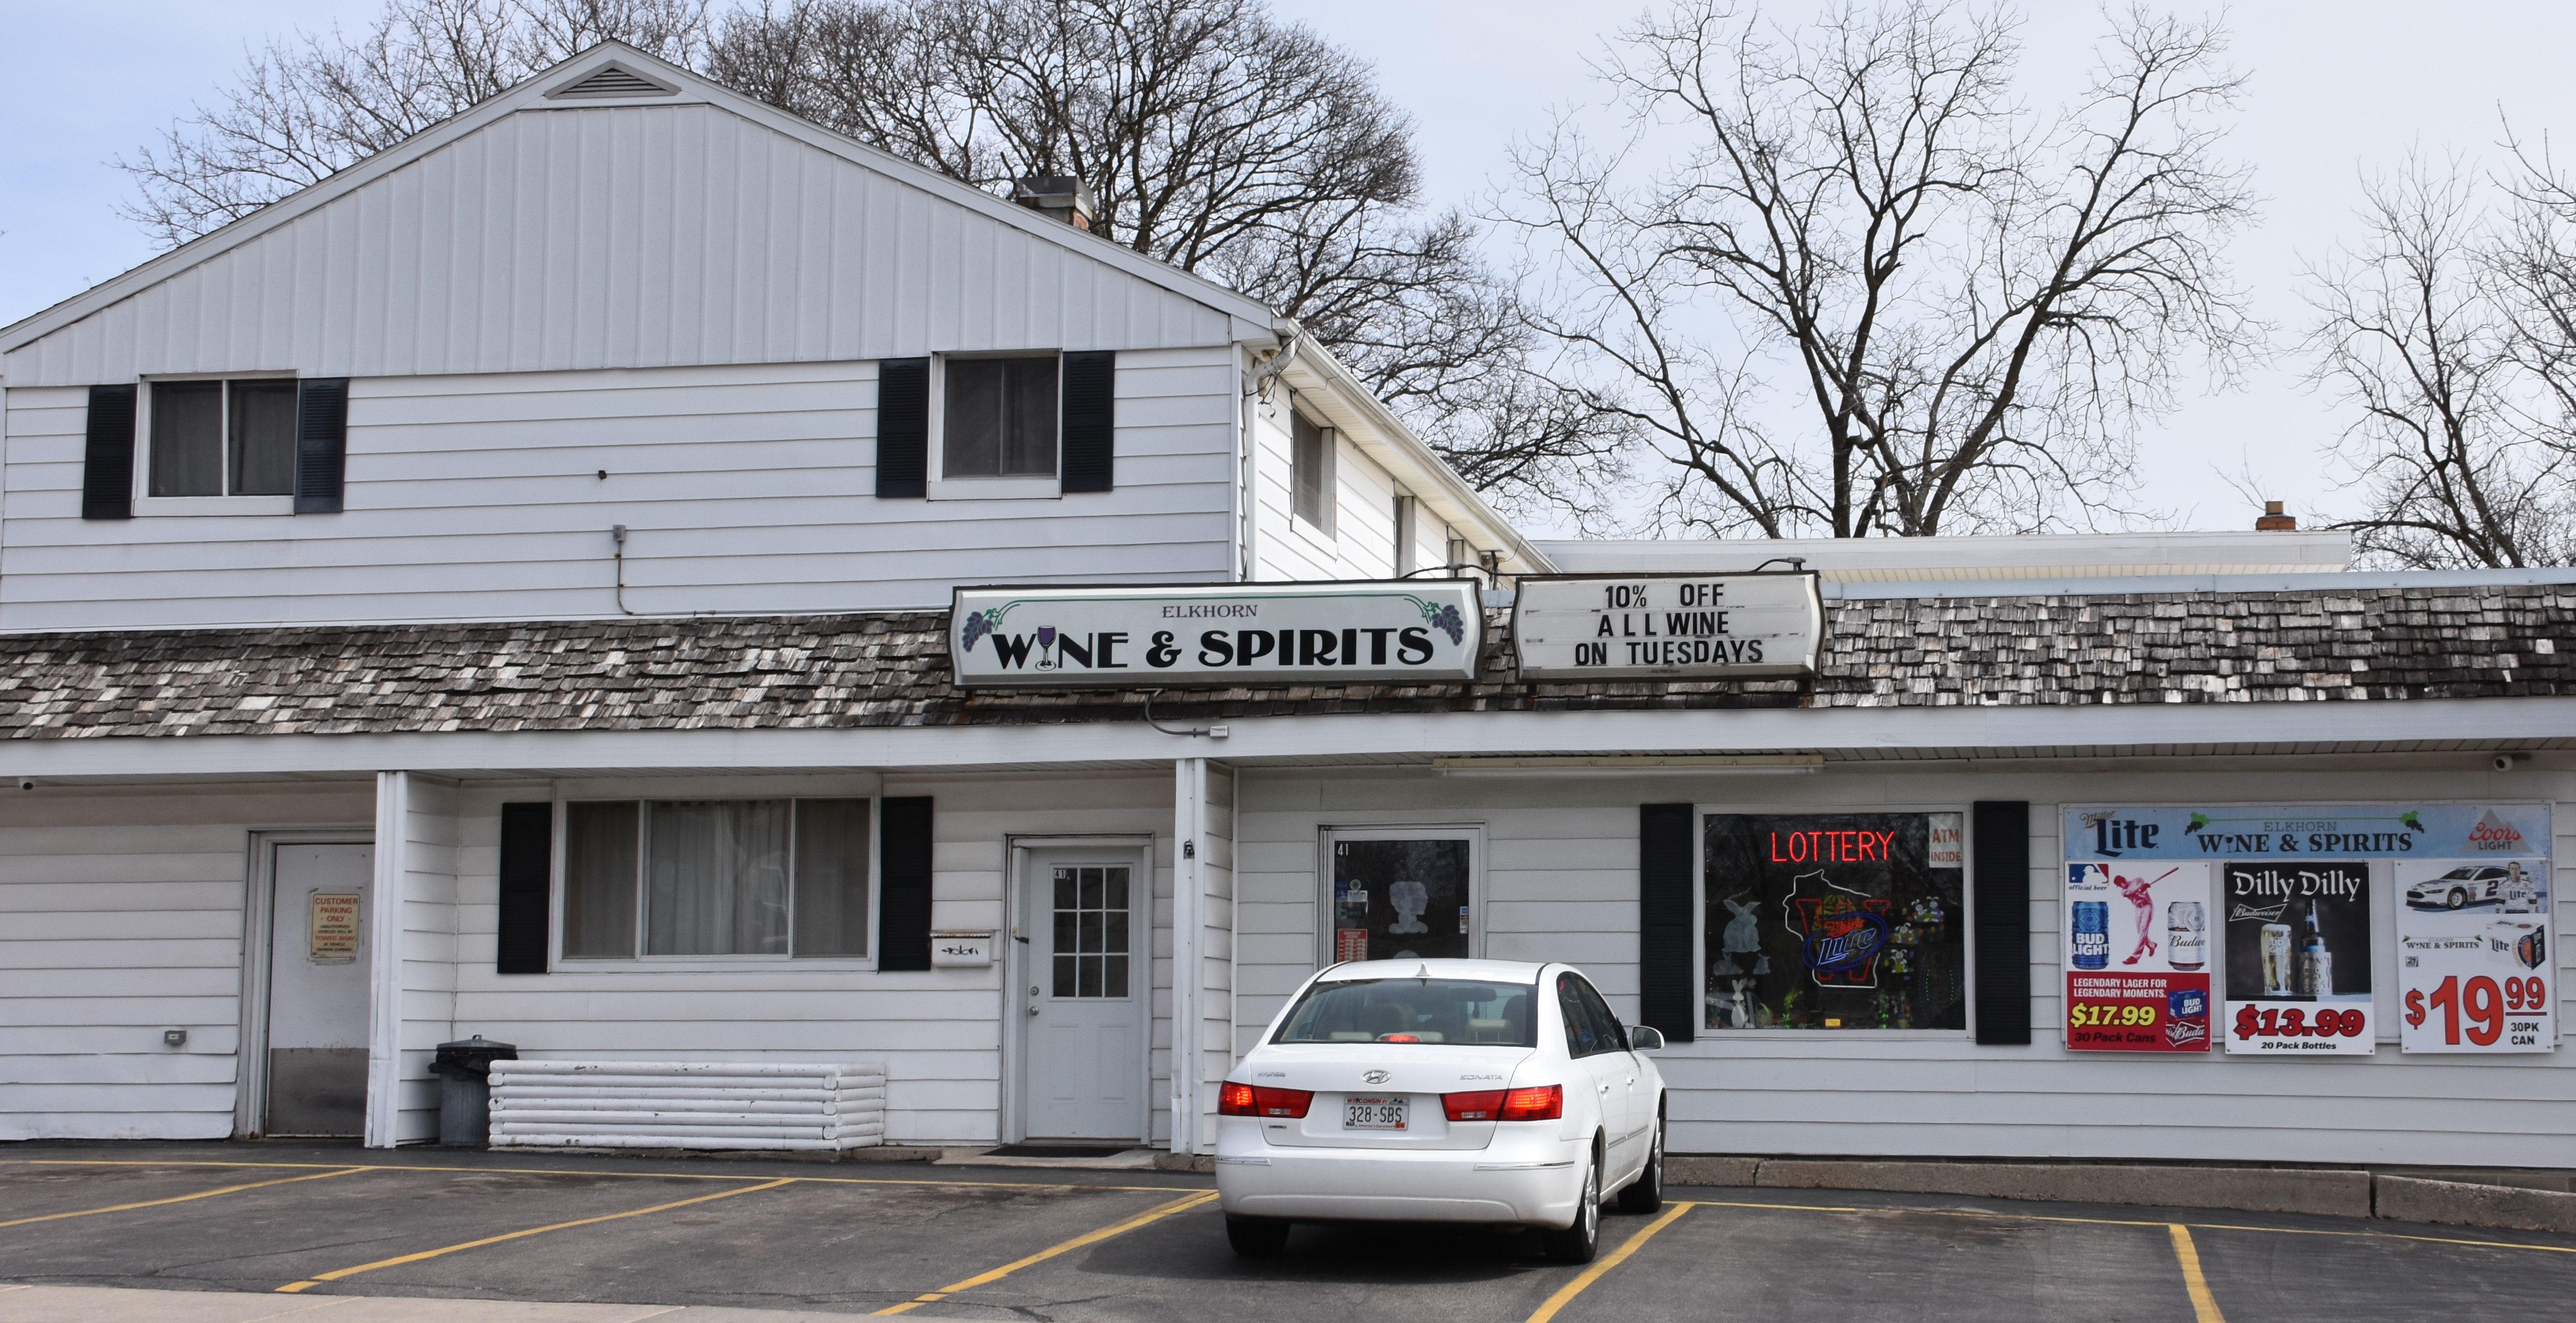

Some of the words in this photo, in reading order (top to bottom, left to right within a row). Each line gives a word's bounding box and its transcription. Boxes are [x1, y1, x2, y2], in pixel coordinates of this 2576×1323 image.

[1605, 585, 1647, 608] 10%
[1680, 583, 1724, 607] OFF
[1162, 605, 1258, 619] ELKHORN
[1597, 614, 1657, 637] ALL
[1666, 611, 1729, 635] WINE
[1145, 631, 1182, 667] &
[1198, 626, 1434, 667] SPIRITS
[1575, 642, 1607, 666] ON
[1626, 639, 1763, 665] TUESDAYS
[2080, 810, 2116, 829] Miller
[2264, 821, 2337, 832] ELKHORN
[1932, 829, 1960, 843] ATM
[2094, 819, 2159, 857] Lite
[2469, 822, 2521, 841] Coors
[1772, 831, 1894, 862] LOTTERY
[2279, 834, 2299, 852] &
[2309, 833, 2413, 852] SPIRITS
[2478, 841, 2512, 850] LIGHT
[1338, 844, 1349, 856] 41
[1931, 851, 1962, 861] INSIDE
[2232, 870, 2294, 902] Dilly
[2298, 870, 2360, 902] Dilly
[2235, 907, 2281, 917] Budweiser
[2076, 933, 2105, 944] BUD
[2492, 938, 2509, 952] Lite
[2073, 944, 2109, 955] LIGHT
[2074, 978, 2121, 987] LEGENDARY
[2123, 979, 2148, 988] LAGER
[2151, 979, 2167, 988] FOR
[2074, 988, 2121, 997] LEGENDARY
[2123, 989, 2167, 998] MOMENTS.
[2182, 1004, 2202, 1014] LIGHT
[2184, 998, 2200, 1007] BUD
[2070, 1002, 2156, 1028] $17.99
[2233, 1004, 2365, 1040] $13.99
[2510, 1022, 2539, 1032] 30PK
[2075, 1032, 2091, 1042] 30
[2093, 1032, 2124, 1042] Pack
[2126, 1032, 2156, 1043] Cans
[2511, 1036, 2534, 1045] CAN
[1349, 1106, 1402, 1123] 328-SBS
